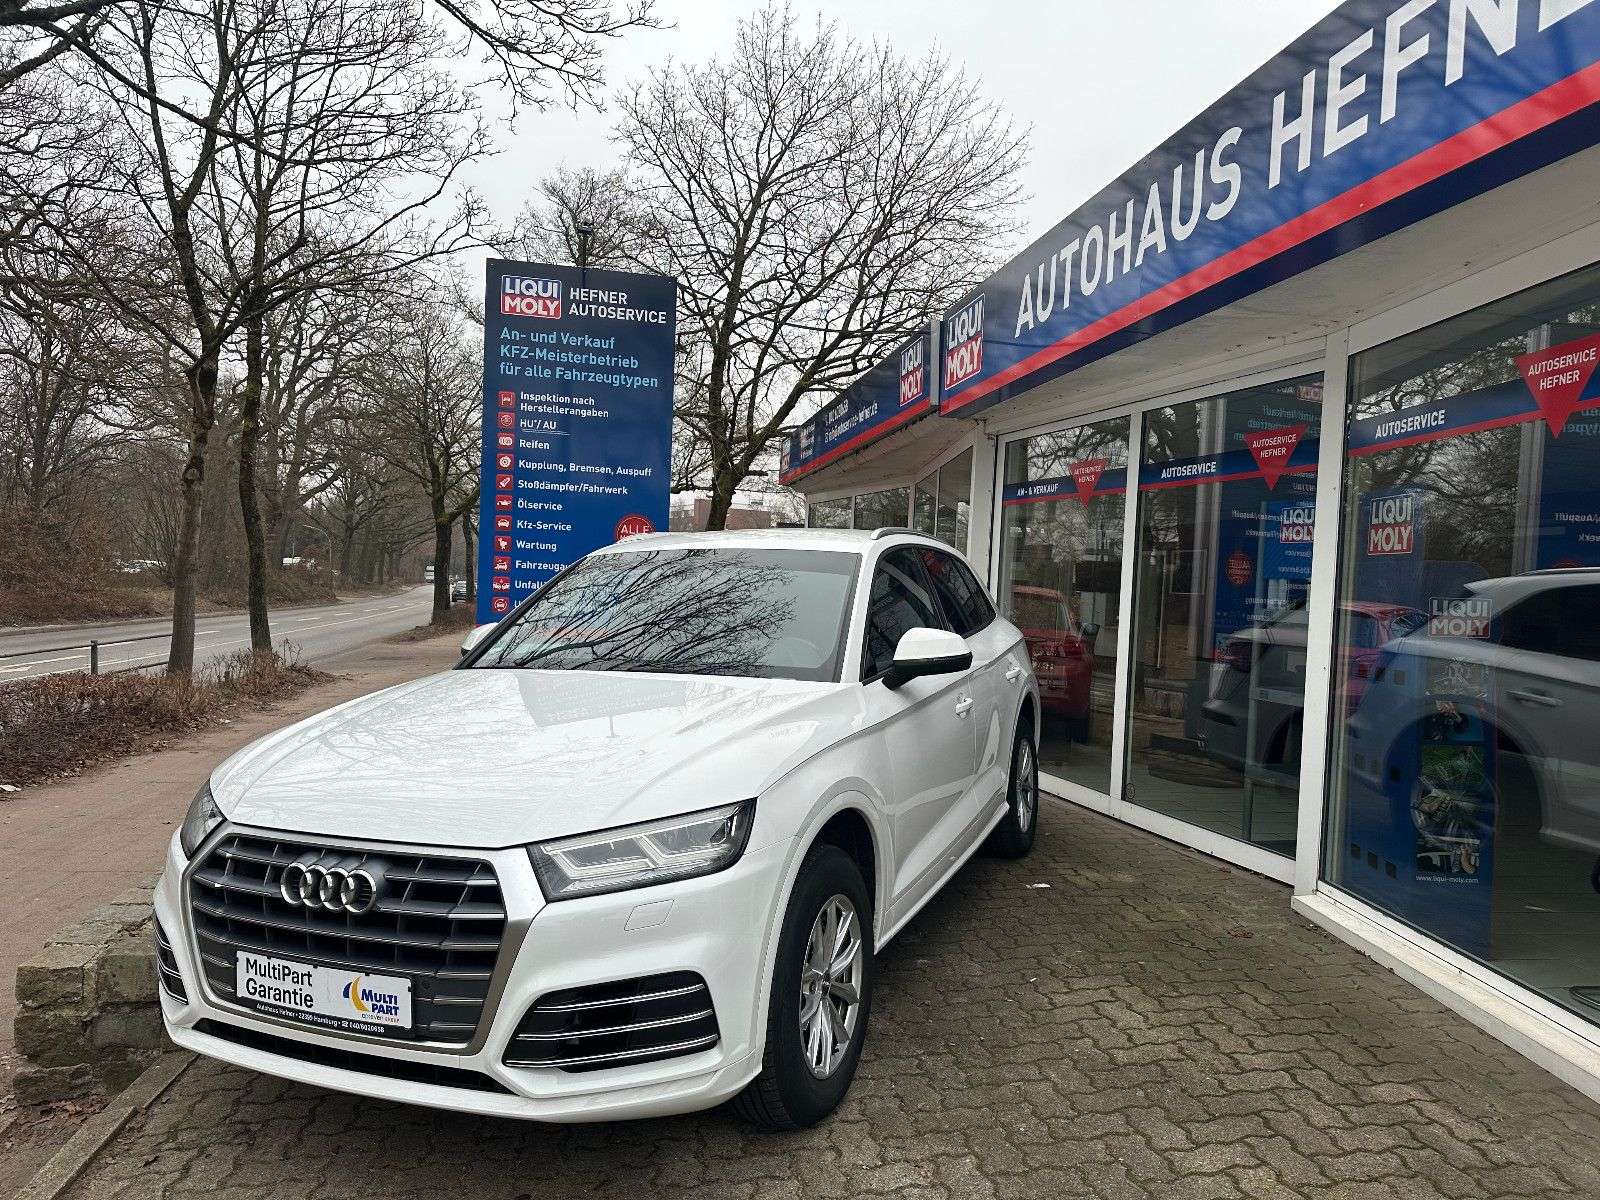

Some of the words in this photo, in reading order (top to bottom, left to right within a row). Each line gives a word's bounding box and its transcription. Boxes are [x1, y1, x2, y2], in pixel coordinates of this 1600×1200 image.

[1014, 126, 1243, 339] AUTOHAUS
[505, 277, 558, 298] LIQUI
[570, 287, 628, 305] HEFNER
[504, 296, 559, 317] MOLY
[569, 303, 667, 324] AUTOSERVICE
[948, 300, 983, 347] LIQUI
[500, 327, 526, 341] An-
[531, 331, 557, 344] und
[561, 333, 615, 350] Verkauf
[500, 345, 639, 369] KFZ-Meisterbetrieb
[901, 340, 922, 375] LIQUI
[946, 337, 982, 385] MOLY
[1527, 347, 1597, 377] AUTOSERVICE
[499, 362, 521, 375] für
[525, 365, 551, 378] alle
[555, 367, 658, 388] Fahrzeugtypen
[1539, 370, 1581, 391] HEFNER
[901, 368, 922, 402] MOLY
[520, 391, 570, 405] Inspektion
[573, 395, 595, 405] nach
[520, 403, 609, 418] Herstellerangaben
[543, 420, 557, 430] AU
[1375, 410, 1445, 439] AUTOSERVICE
[519, 439, 550, 450] Reifen
[1252, 433, 1297, 448] AUTOSERVICE
[1260, 447, 1287, 459] HEFNER
[519, 459, 567, 473] Kupplung,
[569, 462, 614, 475] Bremsen,
[616, 466, 652, 477] Auspuff
[1161, 461, 1217, 479] AUTOSERVICE
[518, 479, 628, 495] Stoßdämpfer/Fahrwerk
[1033, 483, 1059, 495] VERKAUF
[517, 498, 563, 511] Ölservice
[1371, 497, 1412, 524] LIQUI
[517, 519, 572, 531] Kfz-Service
[1283, 509, 1314, 524] LIQU
[620, 523, 650, 534] ALLE
[516, 540, 557, 552] Wartung
[1370, 525, 1412, 553] MOLY
[1432, 599, 1489, 618] LIQUI
[1431, 618, 1489, 637] MOLY
[246, 957, 313, 987] MultiPart
[246, 977, 314, 1009] Garantie
[361, 988, 398, 1006] MULTI
[371, 1003, 400, 1016] PART
